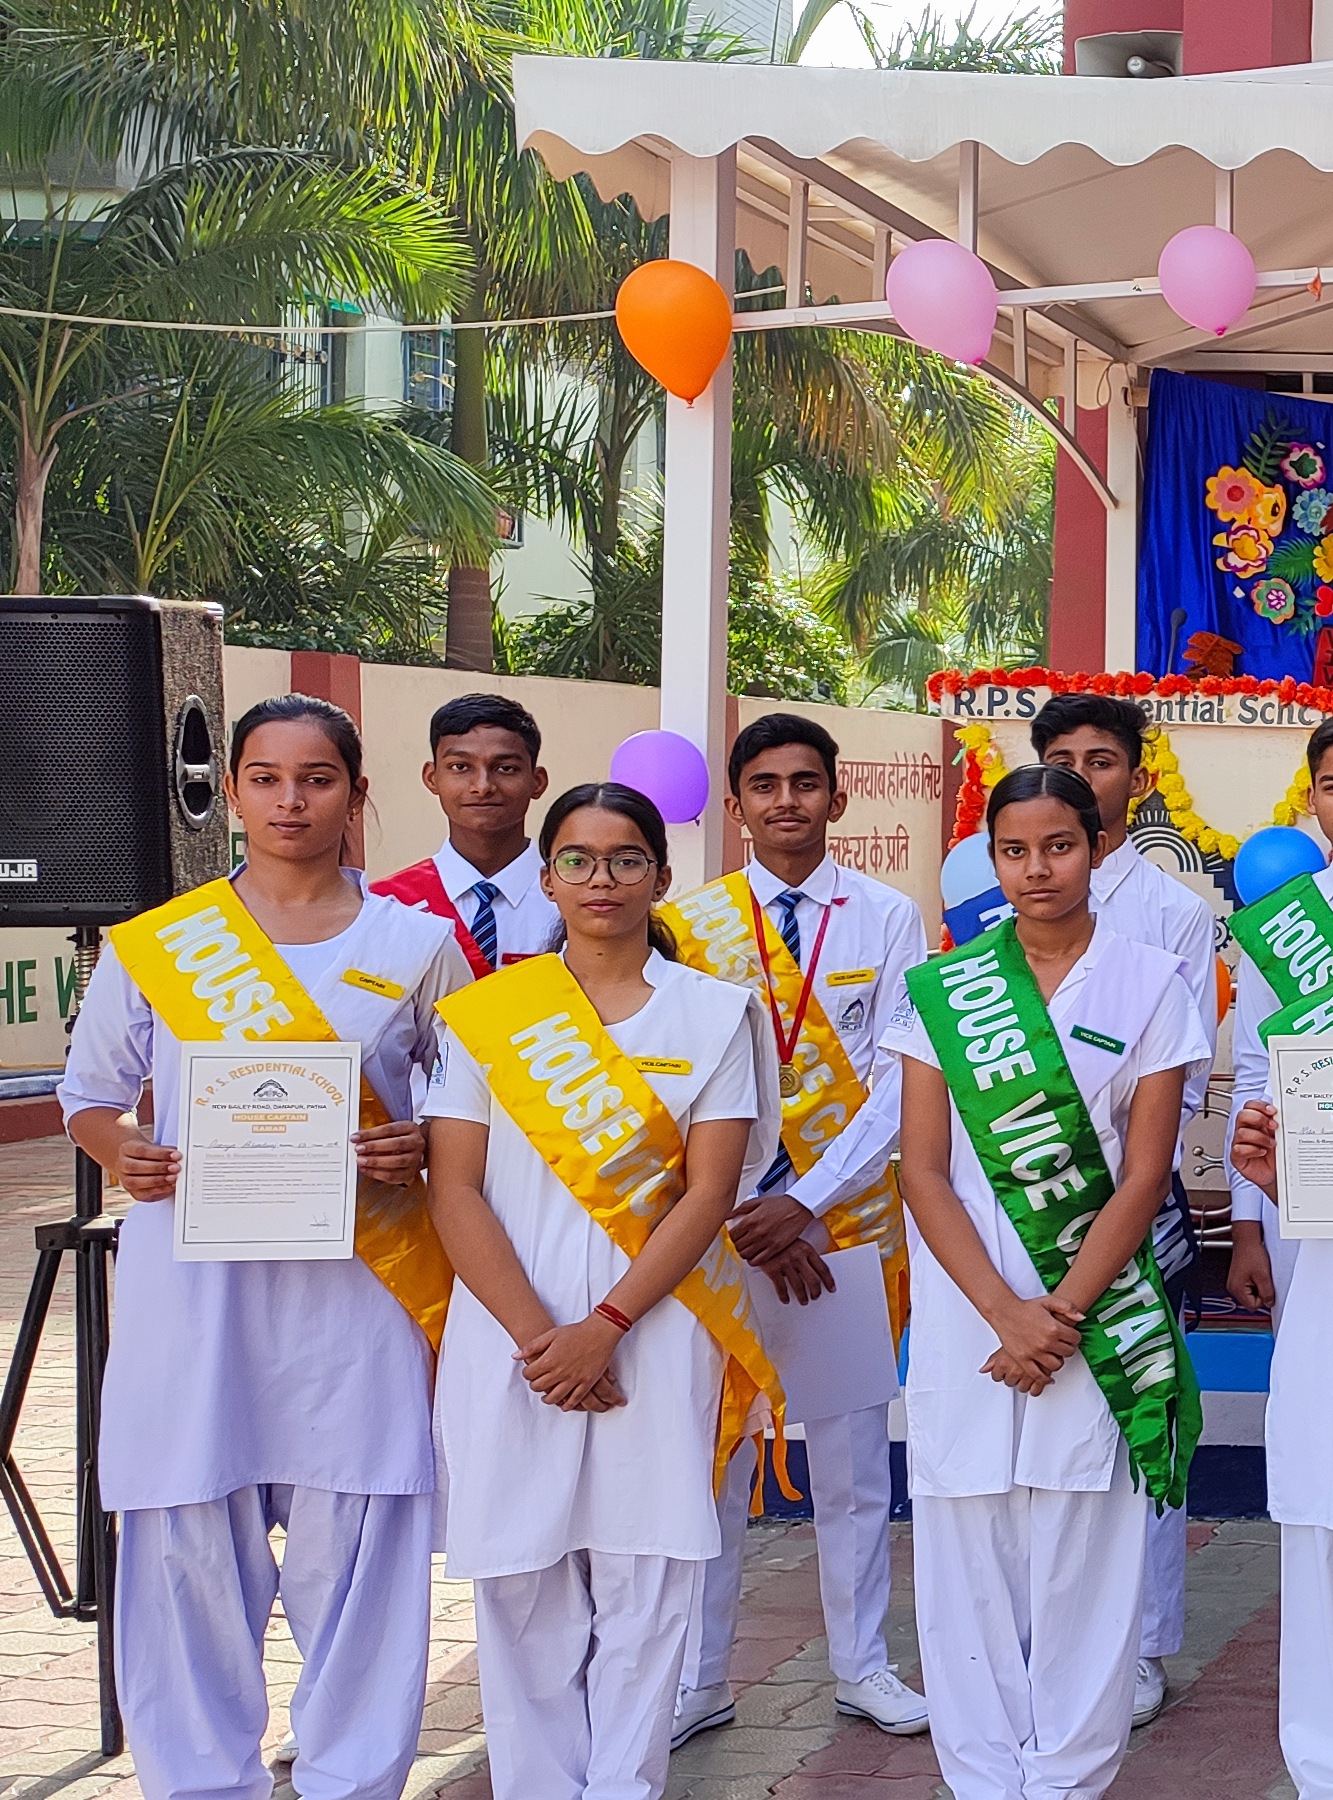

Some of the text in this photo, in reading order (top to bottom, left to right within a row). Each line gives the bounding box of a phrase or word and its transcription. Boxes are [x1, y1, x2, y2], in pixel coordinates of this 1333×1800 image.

[1120, 694, 1226, 724] ential
[1238, 695, 1323, 725] Scho
[838, 752, 942, 807] कामयाब होने के लिए
[871, 826, 883, 873] के
[885, 823, 910, 873] प्रति
[155, 905, 294, 1041] HOUSE
[229, 1063, 306, 1080] RESIDENTIAL
[309, 1072, 346, 1106] SCHOOL
[509, 1011, 684, 1217] HOUSE VIC
[939, 949, 1037, 1091] HOUSE
[989, 1091, 1088, 1212] VICE
[1056, 1210, 1176, 1394] CPTAIN
